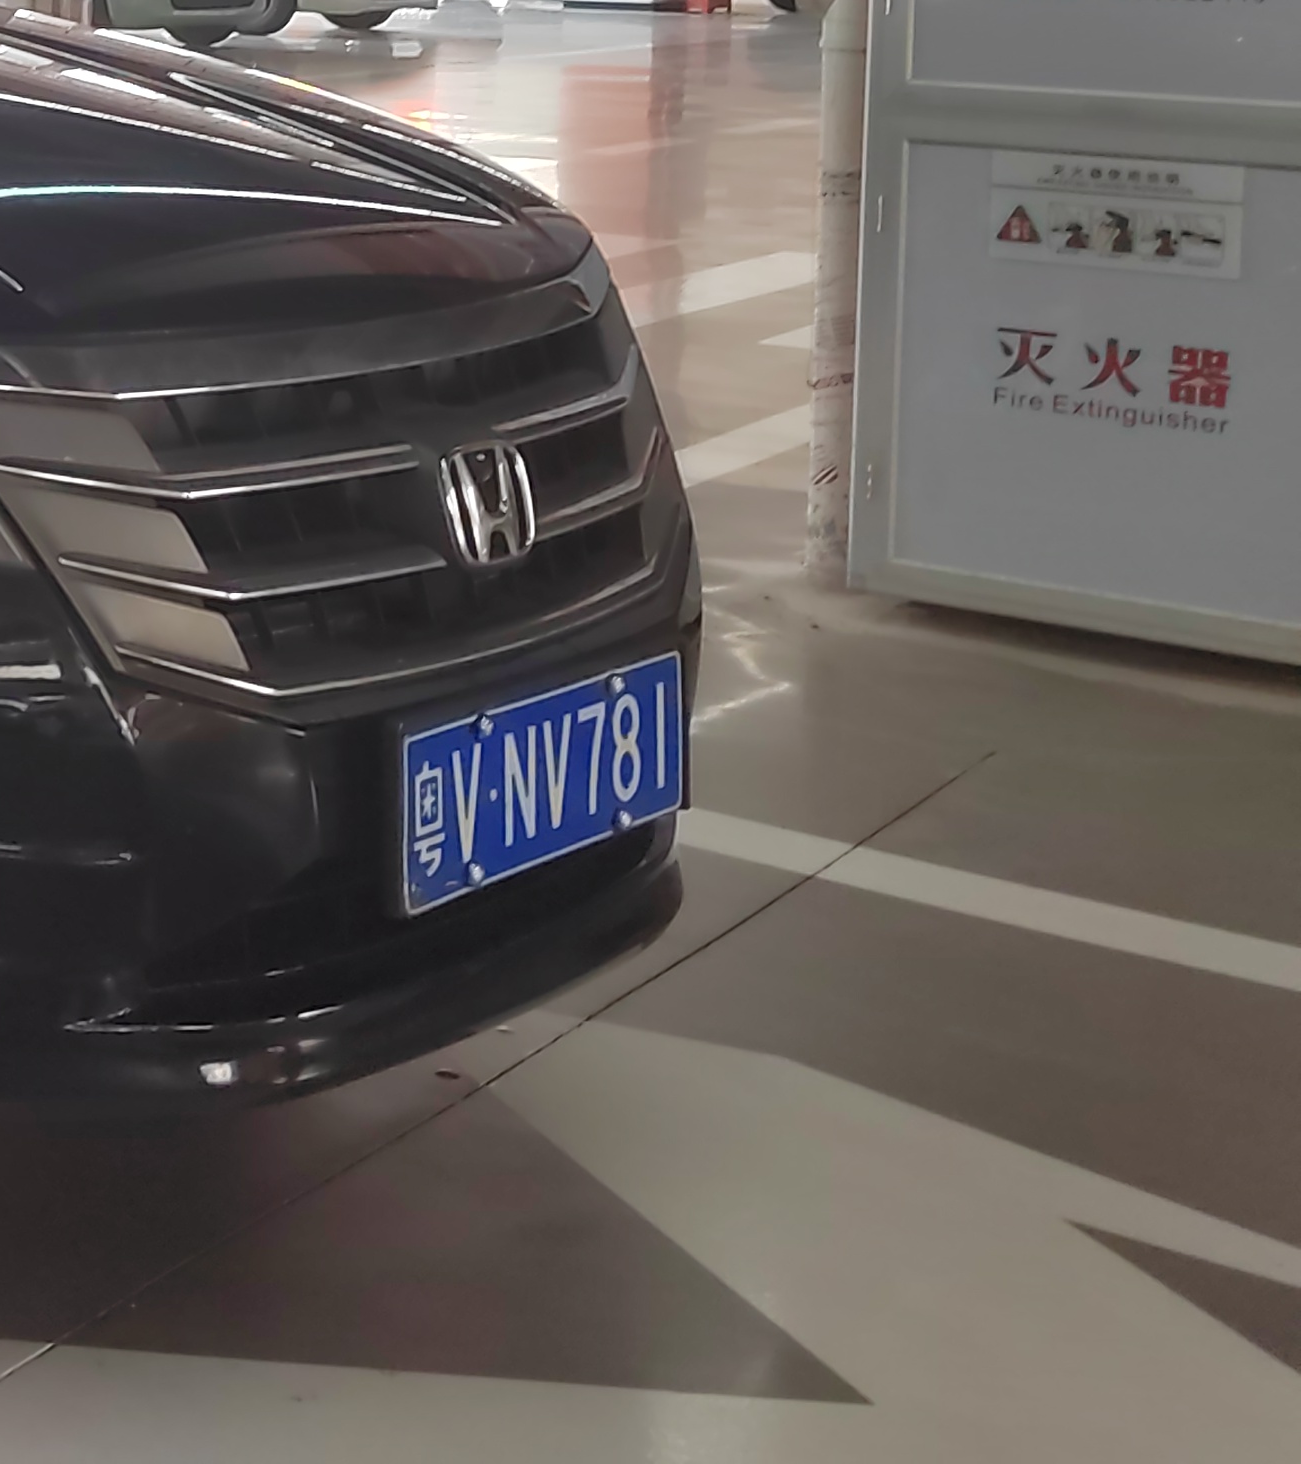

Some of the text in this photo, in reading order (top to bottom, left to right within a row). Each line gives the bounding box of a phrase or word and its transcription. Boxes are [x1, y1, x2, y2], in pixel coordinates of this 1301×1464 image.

[996, 326, 1232, 410] 灭火器
[992, 385, 1231, 435] Fire Extinguisher
